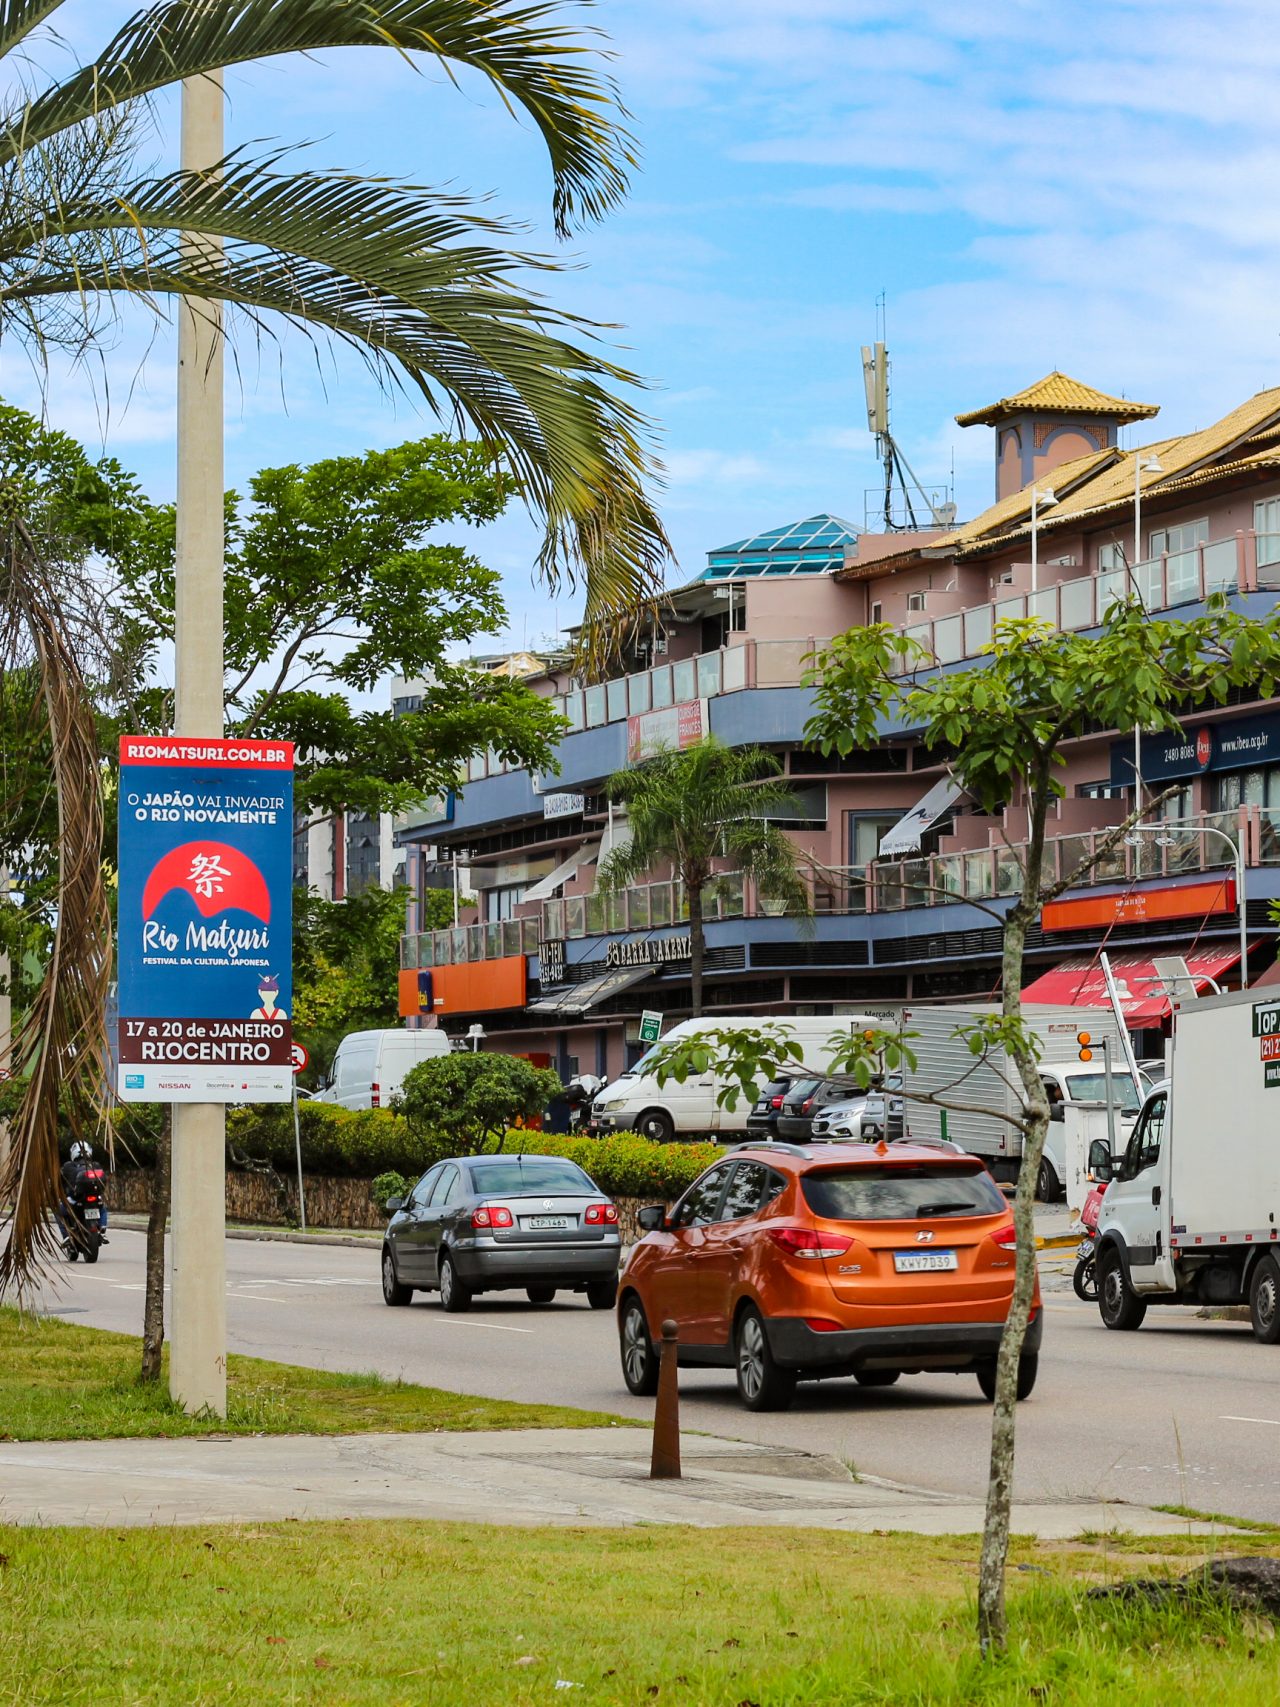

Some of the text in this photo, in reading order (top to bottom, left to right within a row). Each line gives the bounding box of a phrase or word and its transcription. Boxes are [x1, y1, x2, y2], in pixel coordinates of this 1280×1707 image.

[1221, 731, 1269, 752] www.ibeu.org.br
[127, 745, 286, 763] RIOMATSURI.COM.BR
[1164, 744, 1195, 762] 2480 8085
[128, 790, 285, 809] O JAPÃO VAI INVADIR
[135, 809, 277, 824] O RIO NOVAMENTE
[186, 852, 232, 899] 祭
[143, 919, 270, 958] Rio Matsuri
[143, 957, 270, 967] FESTIVAL DA CULTURA JAPONESA
[864, 1010, 895, 1018] Mercado
[1255, 1003, 1277, 1034] TOP
[126, 1021, 284, 1039] 17 a 20 de JANEIRO
[141, 1042, 271, 1061] RIOCENTRO
[1261, 1037, 1274, 1059] (21)
